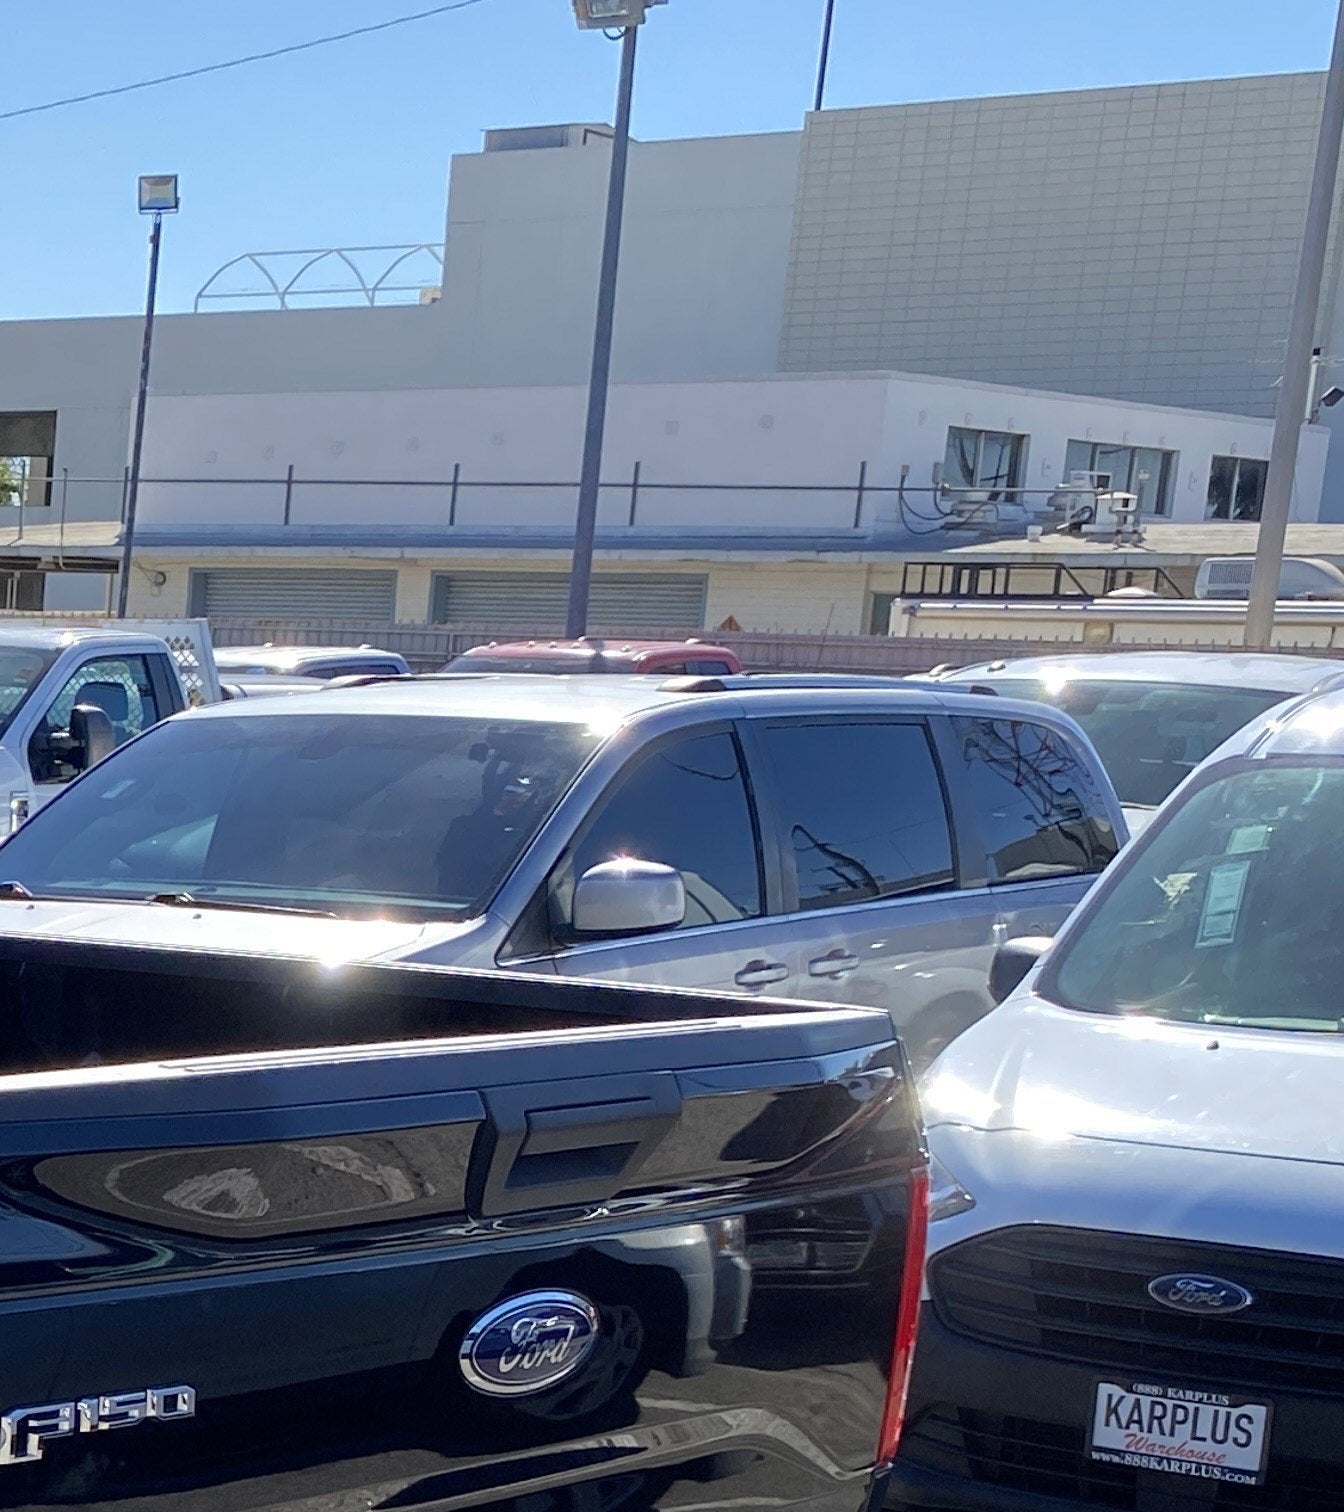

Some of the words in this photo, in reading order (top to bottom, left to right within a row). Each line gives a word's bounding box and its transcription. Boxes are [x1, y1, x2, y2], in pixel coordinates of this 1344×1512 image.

[498, 1315, 576, 1374] Ford
[1132, 1382, 1163, 1397] (888)
[1166, 1387, 1231, 1406] KARPLUS
[1103, 1393, 1255, 1449] KARPLUS
[1124, 1432, 1227, 1464] Warehouse
